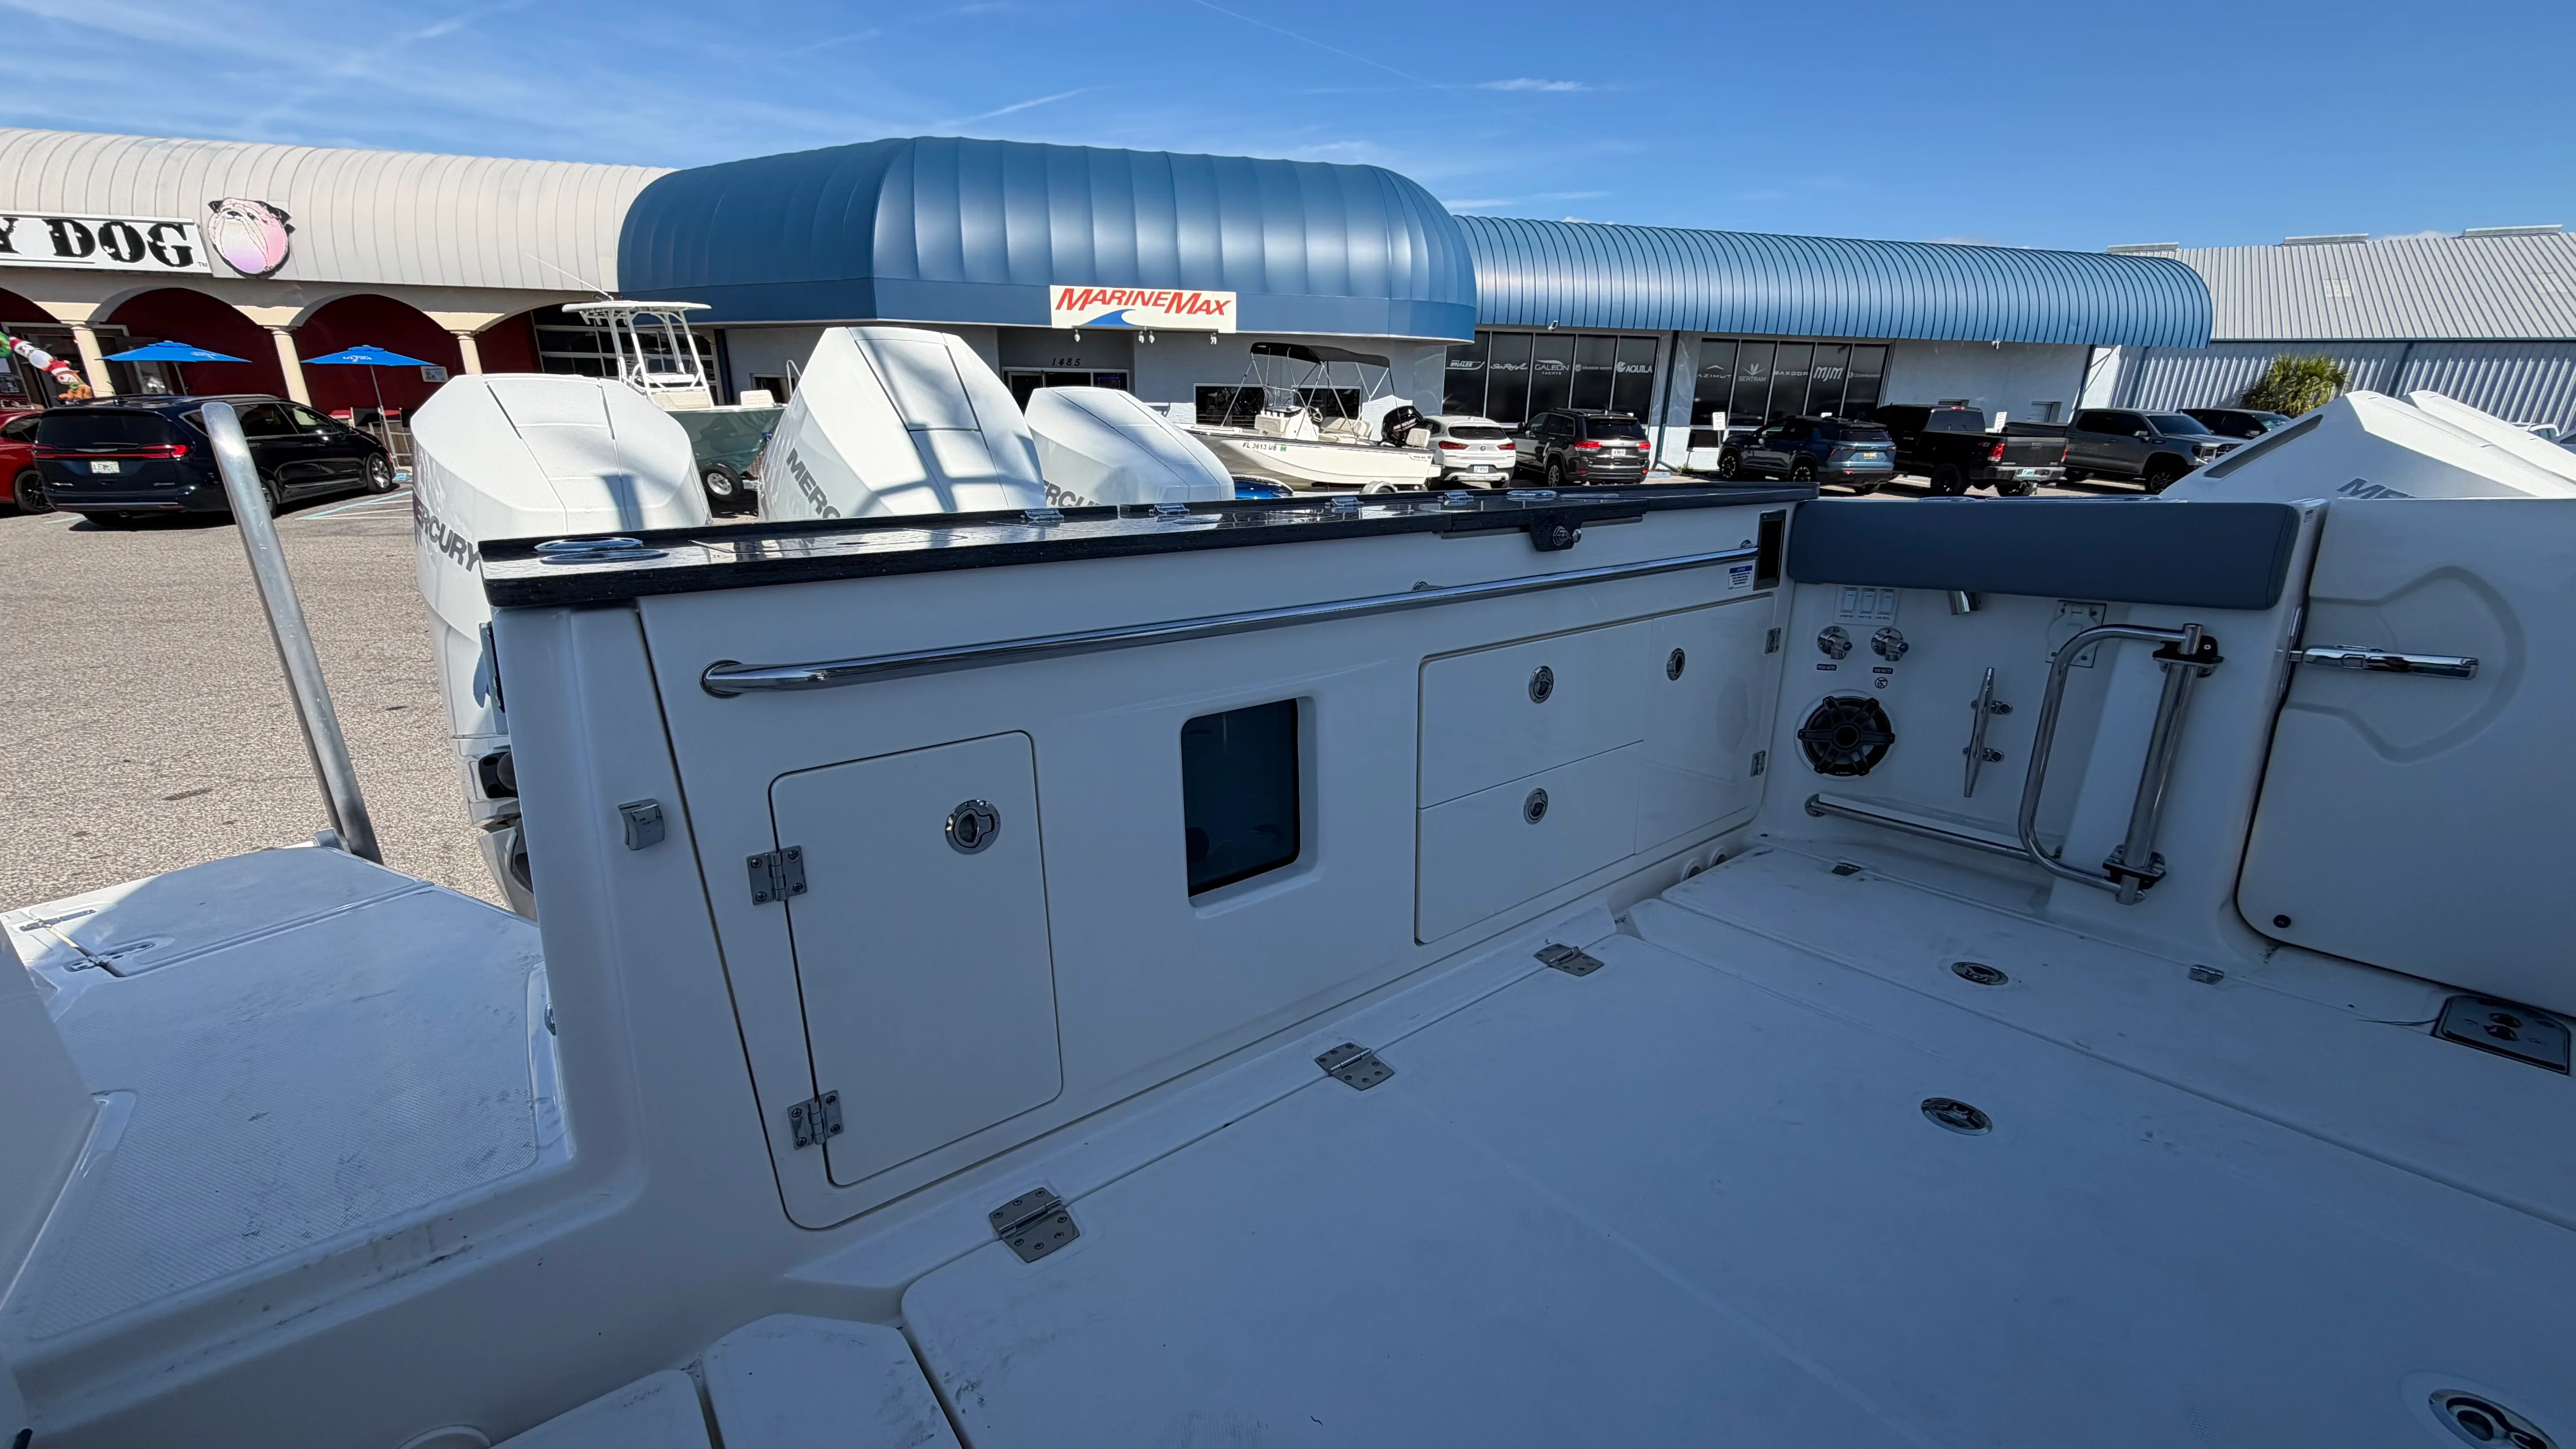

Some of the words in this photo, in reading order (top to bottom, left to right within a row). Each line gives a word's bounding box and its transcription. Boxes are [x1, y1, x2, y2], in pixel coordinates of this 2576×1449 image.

[42, 219, 194, 267] DOG
[1052, 357, 1081, 367] 1485
[1625, 365, 1653, 373] AQUILA
[786, 447, 841, 519] MERC
[414, 500, 480, 572] ERCURY
